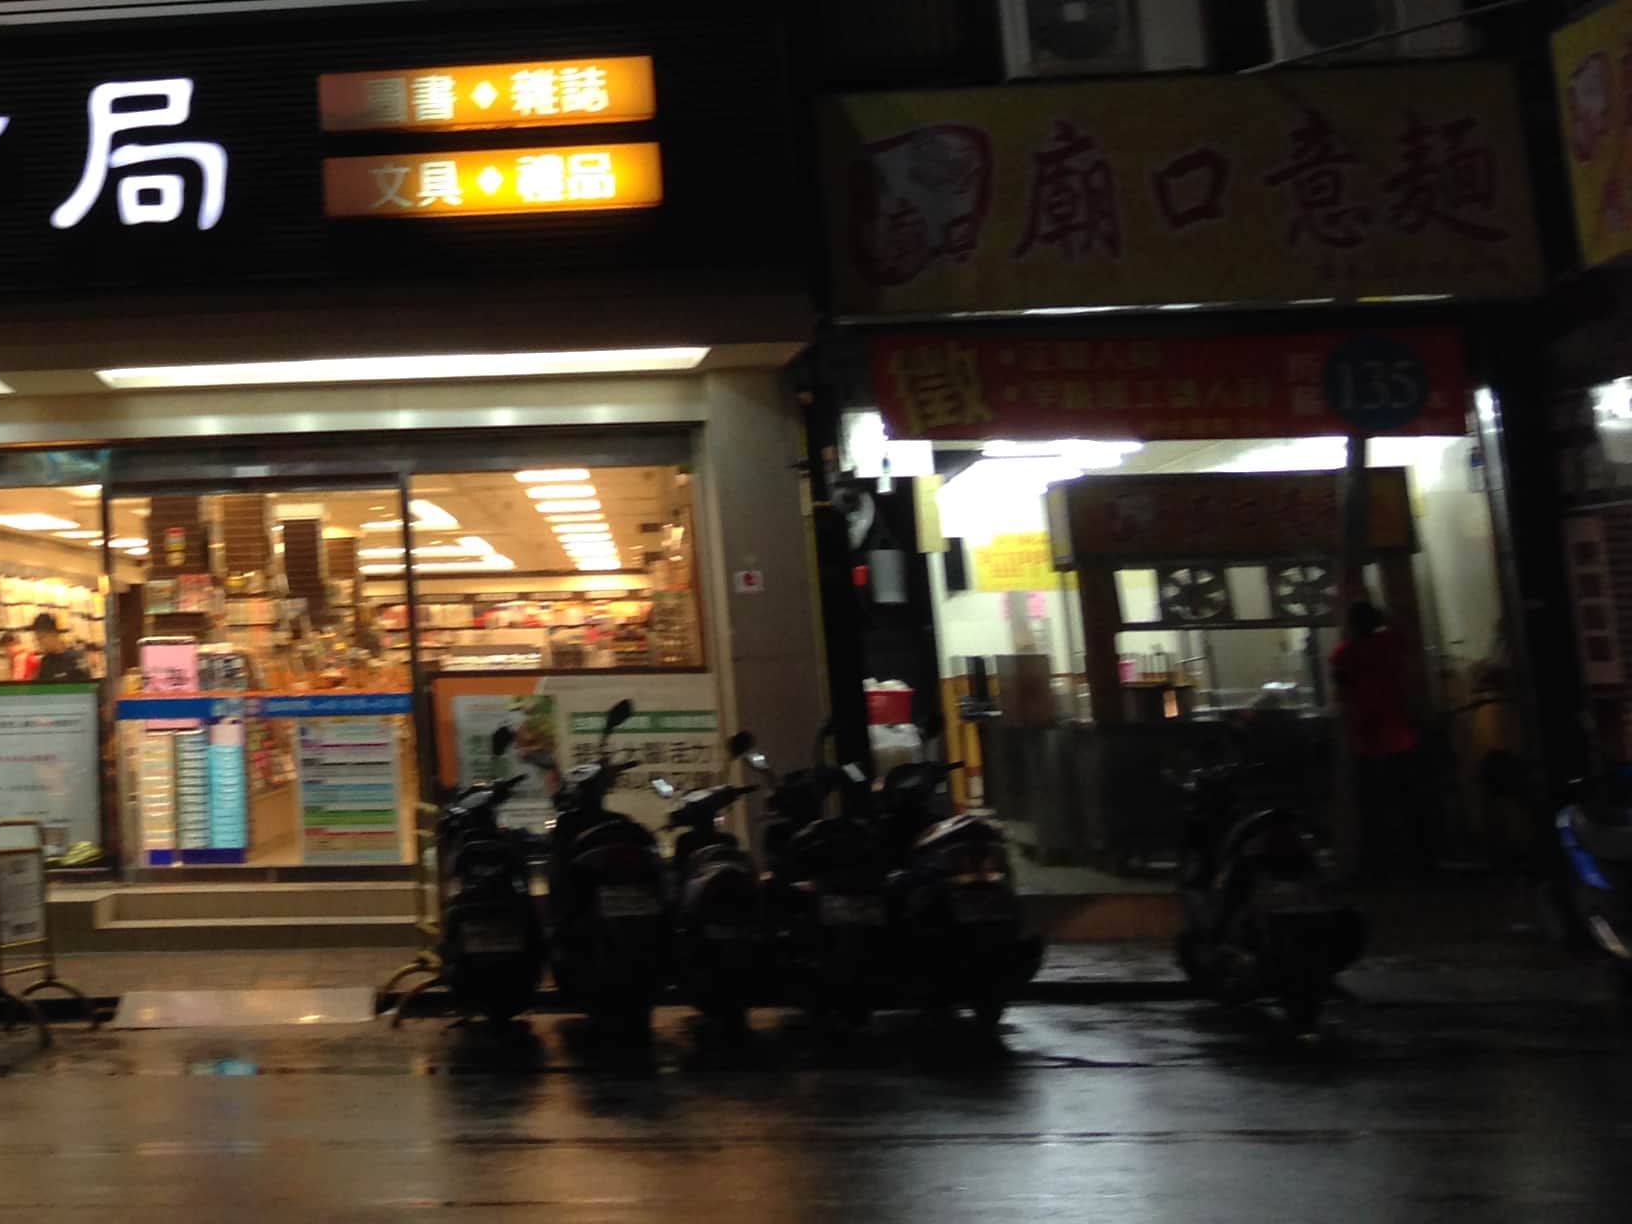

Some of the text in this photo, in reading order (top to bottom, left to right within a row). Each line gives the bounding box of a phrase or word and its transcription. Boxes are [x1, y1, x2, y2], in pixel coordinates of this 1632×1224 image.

[363, 66, 610, 122] 圖書 雜誌
[369, 152, 617, 209] 文具 禮品
[1012, 108, 1511, 263] 廟口意麵
[1335, 358, 1421, 412] 135
